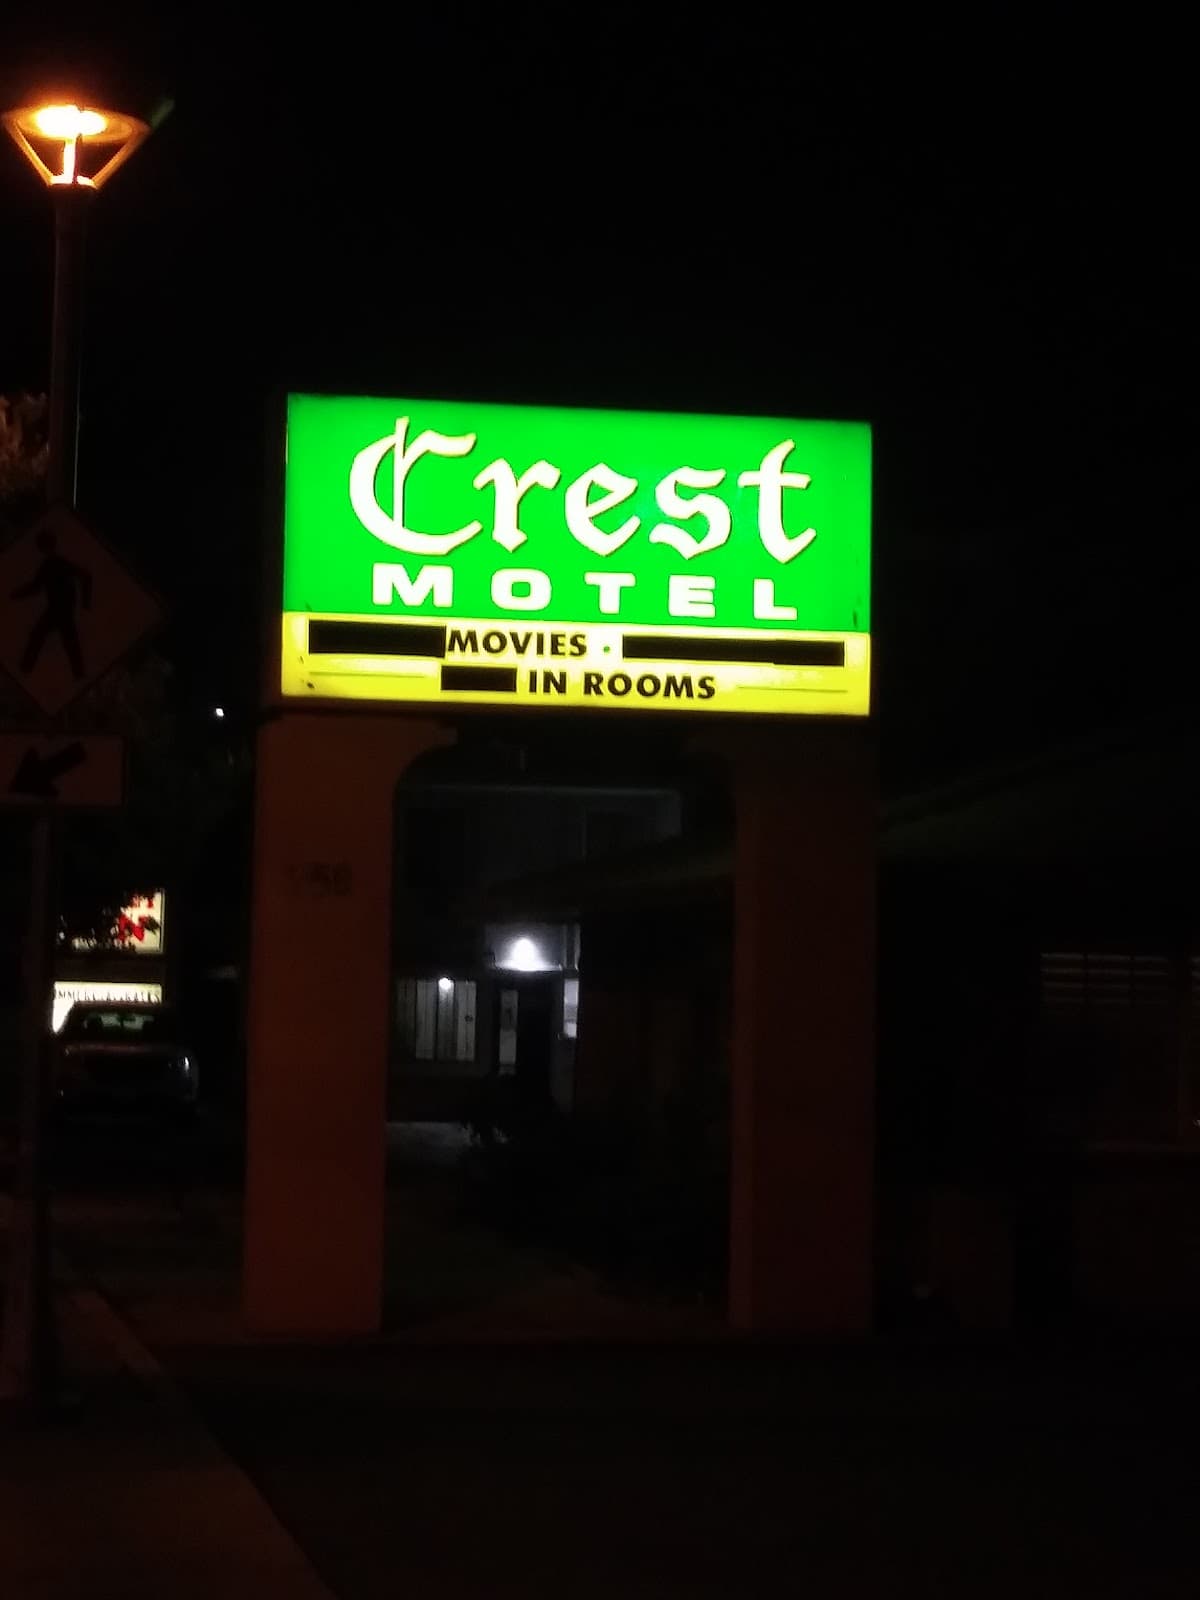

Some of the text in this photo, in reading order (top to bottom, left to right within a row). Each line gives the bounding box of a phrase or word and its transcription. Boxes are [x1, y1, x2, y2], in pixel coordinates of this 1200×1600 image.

[349, 416, 816, 563] Crest
[372, 563, 798, 620] MOTEL
[446, 630, 588, 657] MOVIES
[529, 671, 715, 699] IN ROOMS
